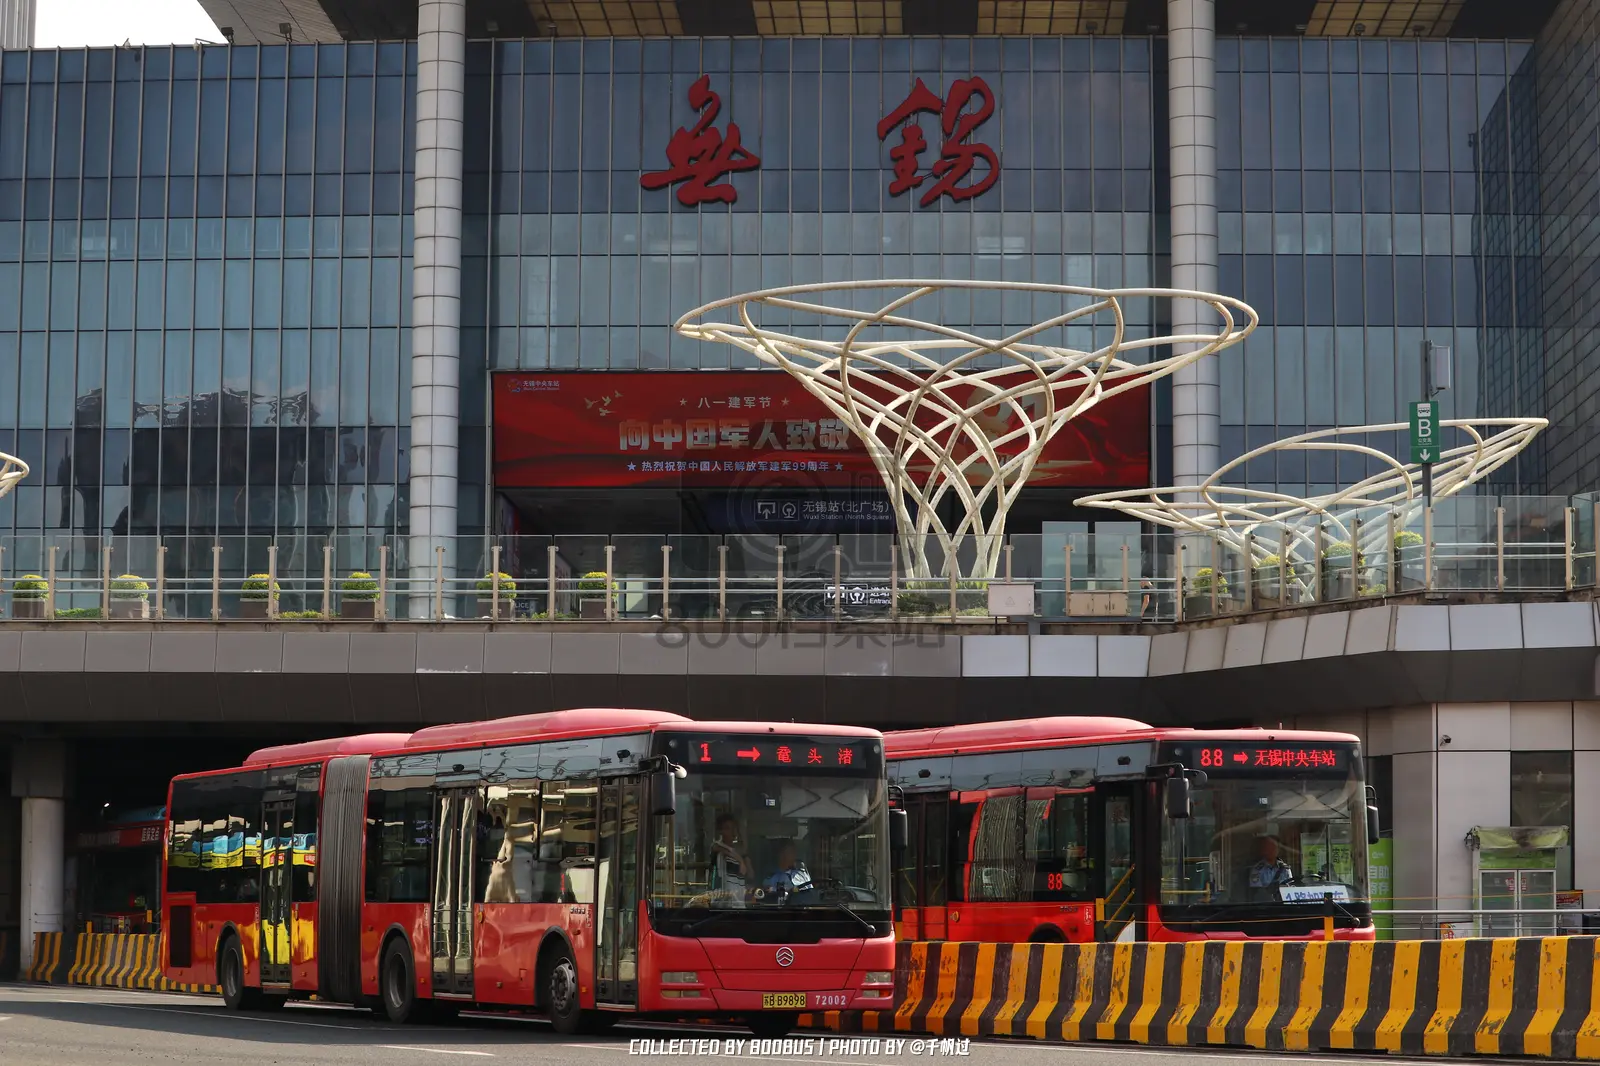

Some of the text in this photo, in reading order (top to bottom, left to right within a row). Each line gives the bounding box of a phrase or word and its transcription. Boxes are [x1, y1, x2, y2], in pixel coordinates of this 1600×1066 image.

[698, 396, 772, 409] 八一建军节
[620, 419, 850, 451] 向中国军人致敬
[1418, 419, 1431, 437] B
[641, 460, 829, 473] 热烈祝贺中国人民解放军建军99周年
[701, 743, 711, 762] 1
[1201, 749, 1223, 766] 88
[1254, 750, 1336, 766] 无锡中央车站
[1047, 873, 1063, 890] 88
[816, 995, 846, 1005] 72002
